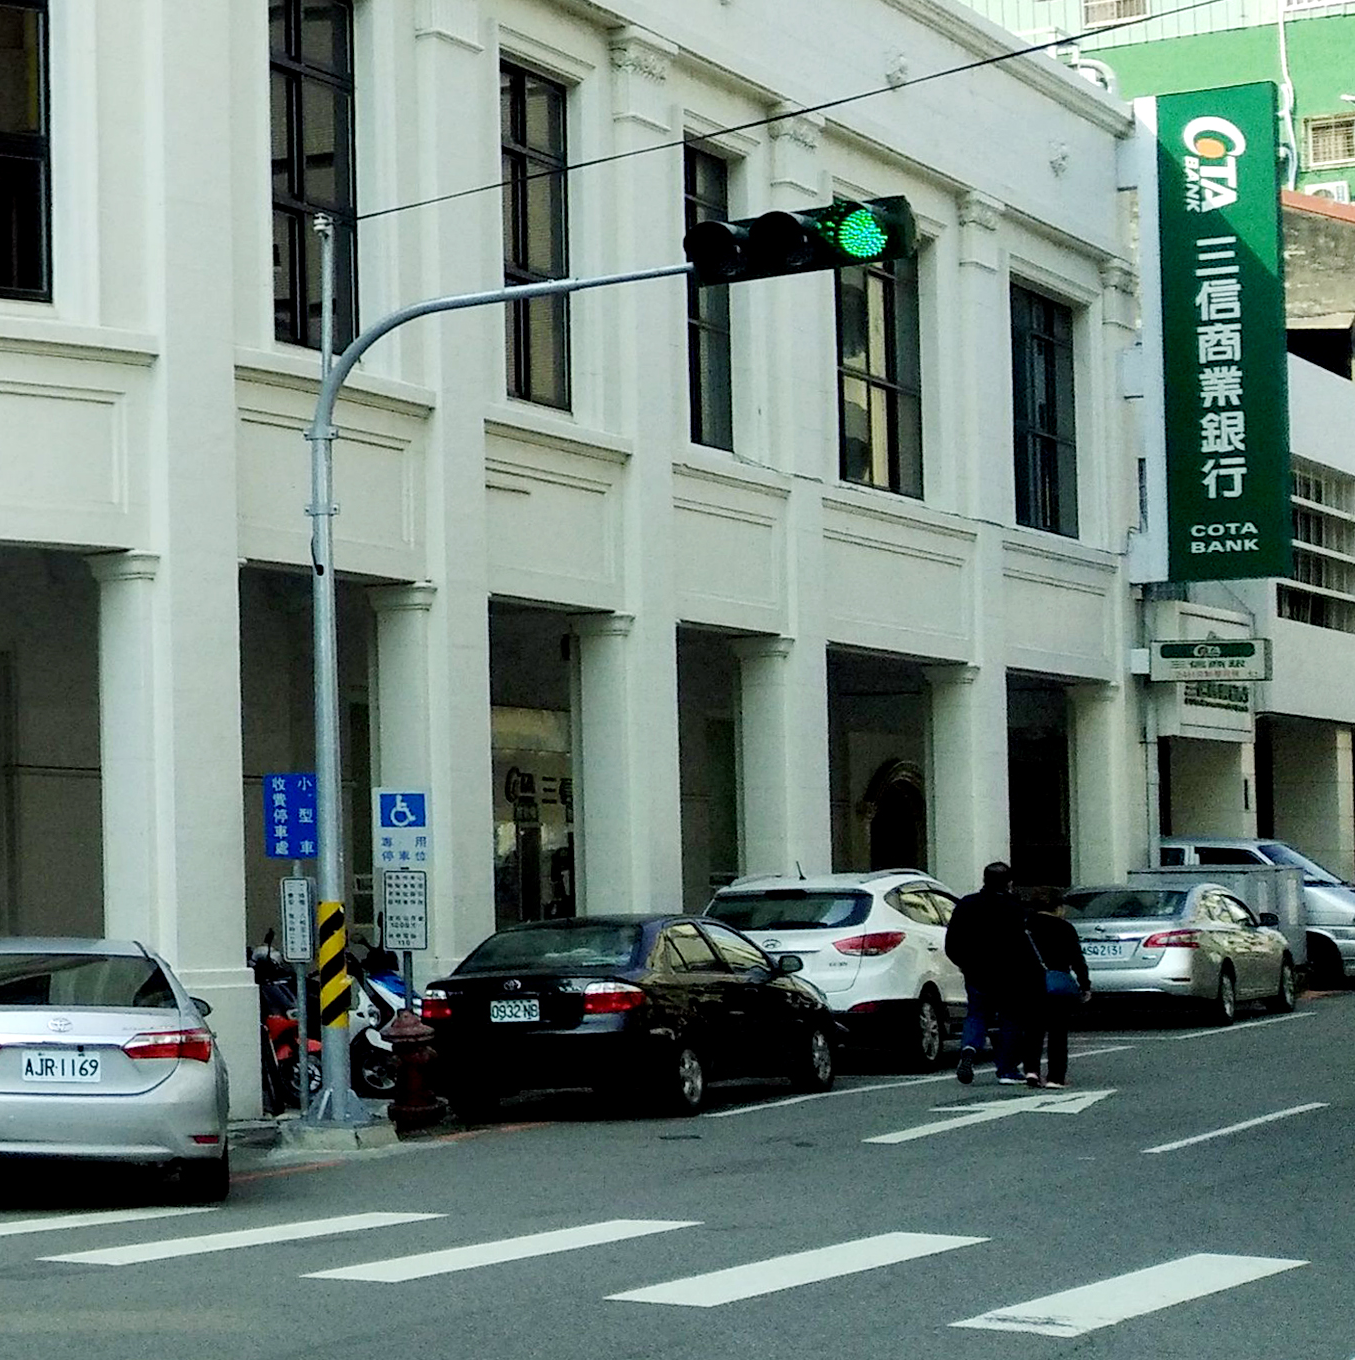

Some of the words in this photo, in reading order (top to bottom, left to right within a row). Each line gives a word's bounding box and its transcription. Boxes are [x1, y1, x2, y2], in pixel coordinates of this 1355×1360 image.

[1184, 155, 1201, 213] BANK
[1195, 236, 1248, 499] 三信商業銀行
[1190, 521, 1259, 538] COTA
[1190, 538, 1260, 554] BANK
[272, 776, 290, 856] 收費停車處
[297, 776, 315, 856] 小型車
[381, 850, 427, 862] 停車位
